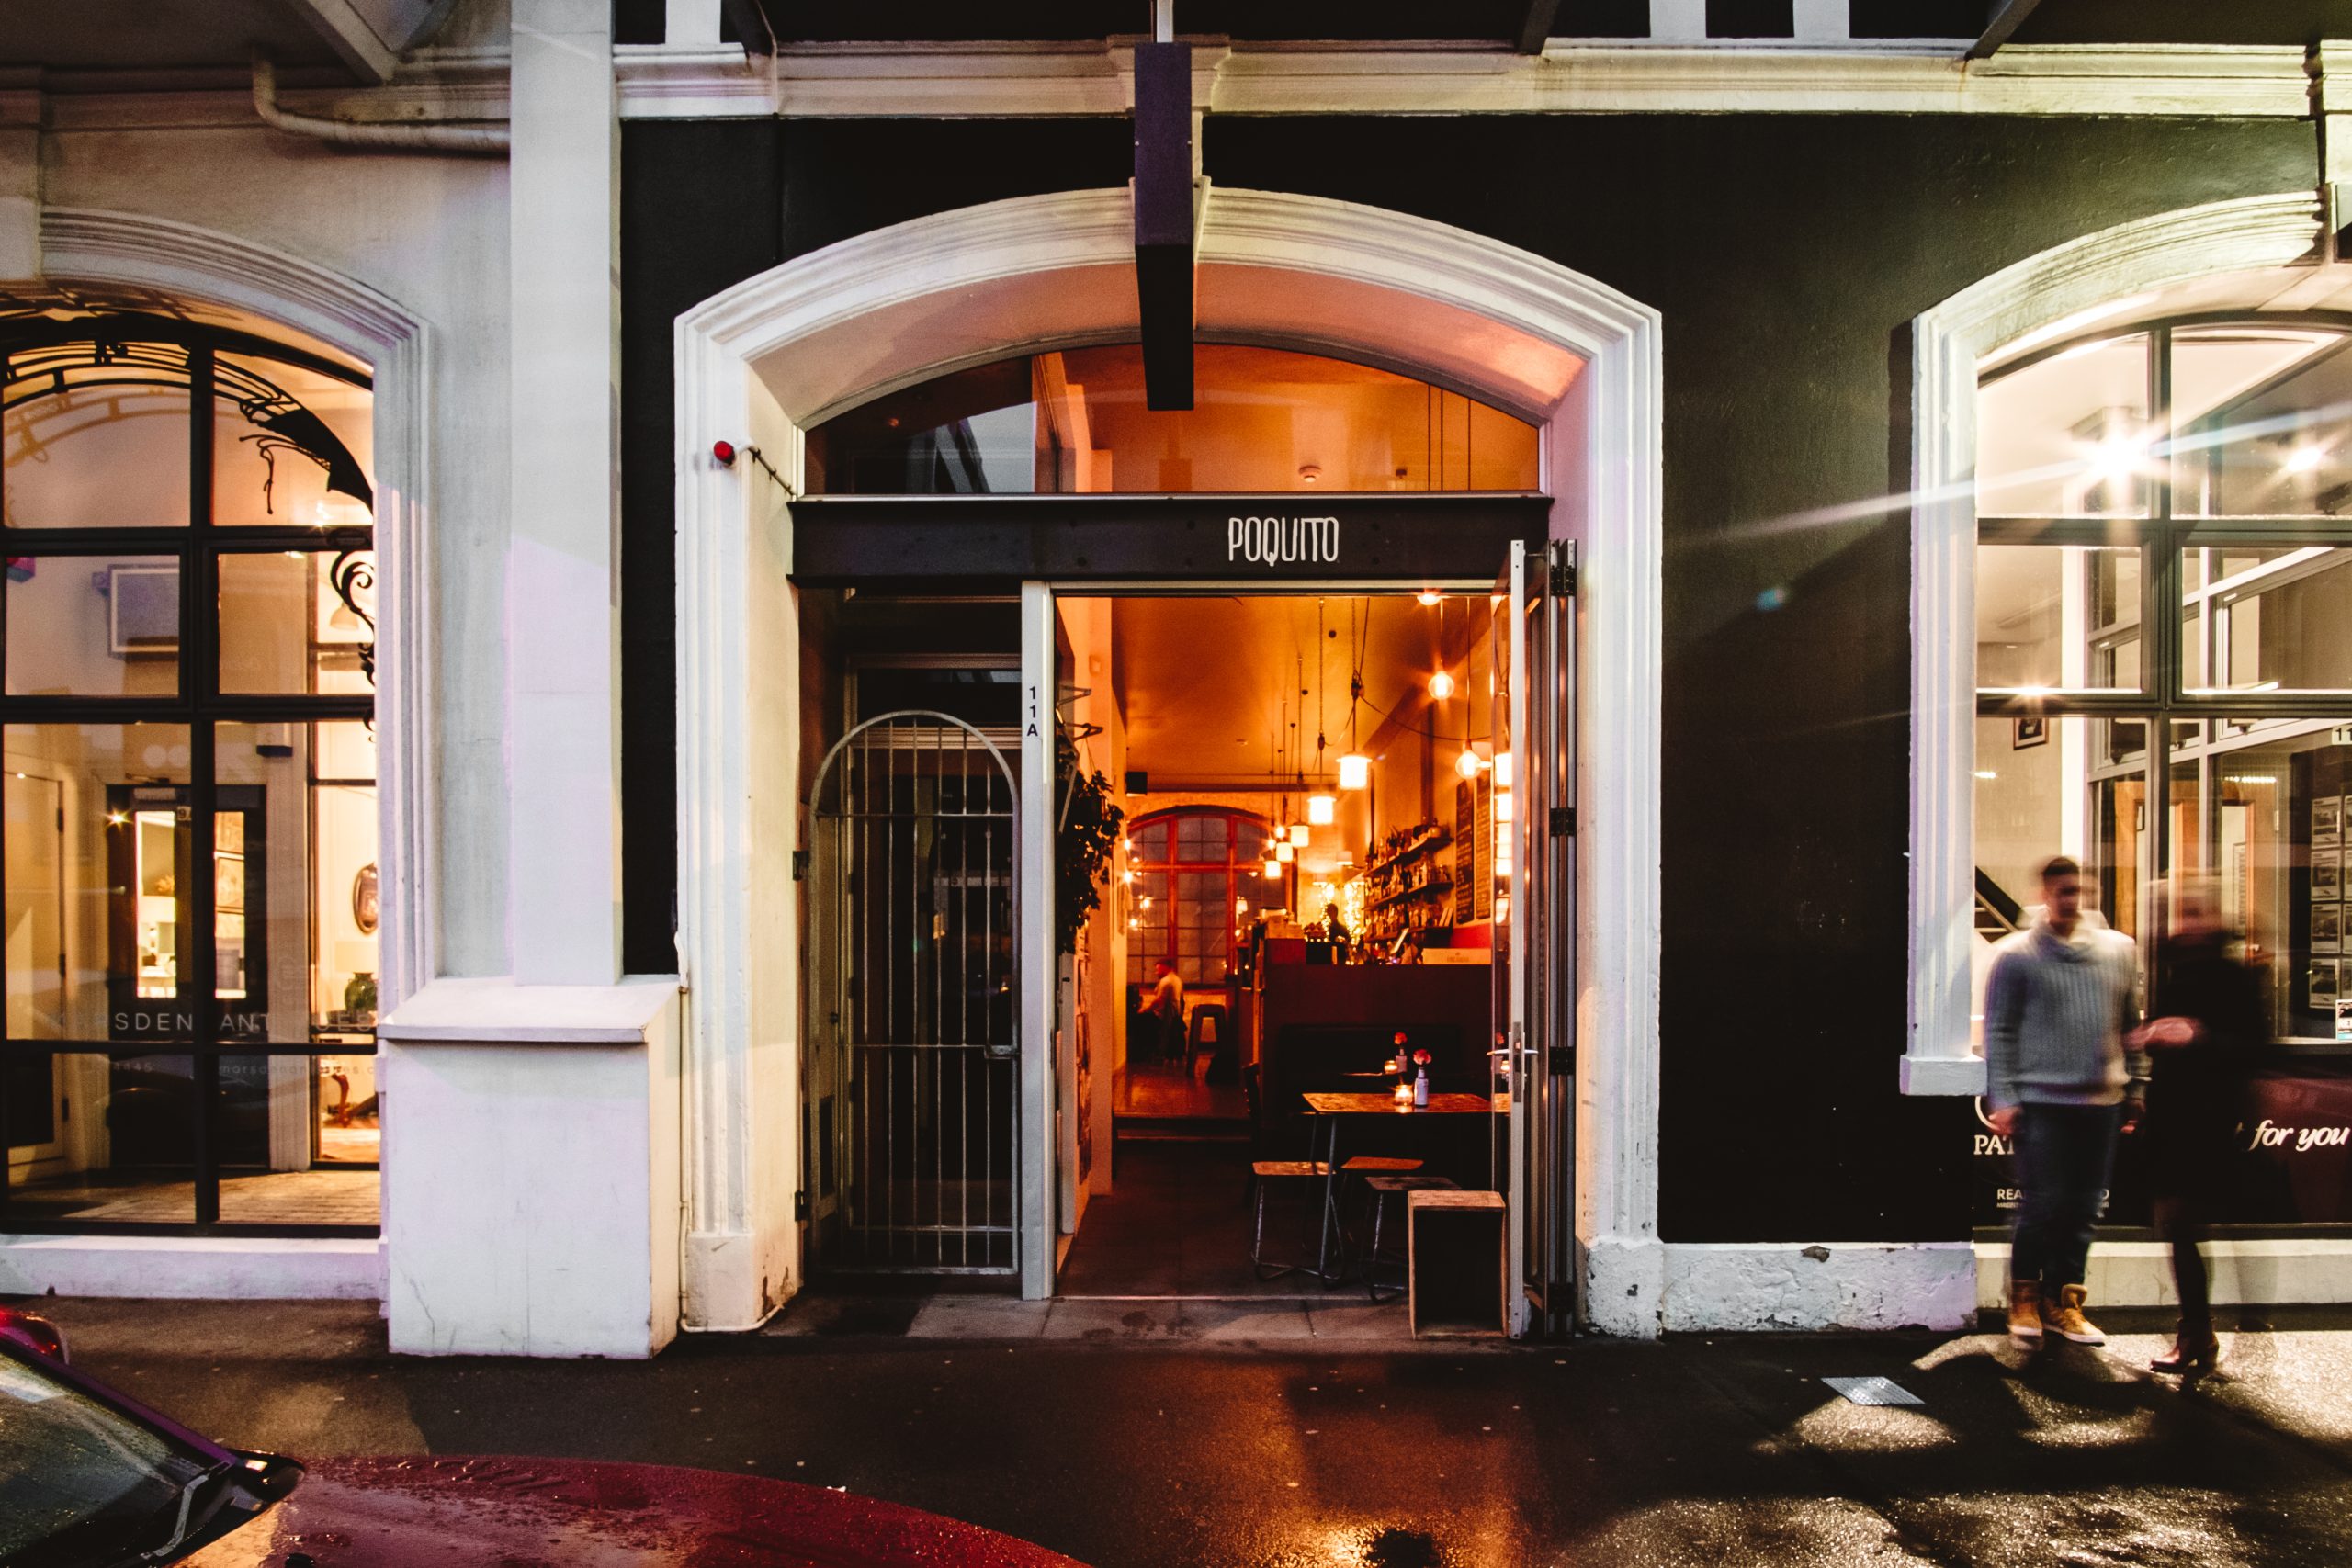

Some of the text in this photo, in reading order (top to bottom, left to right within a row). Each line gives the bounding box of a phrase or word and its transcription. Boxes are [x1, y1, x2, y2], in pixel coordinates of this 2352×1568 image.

[1228, 517, 1340, 567] POQUITO
[2248, 1119, 2294, 1151] for
[1996, 1189, 2026, 1201] REA
